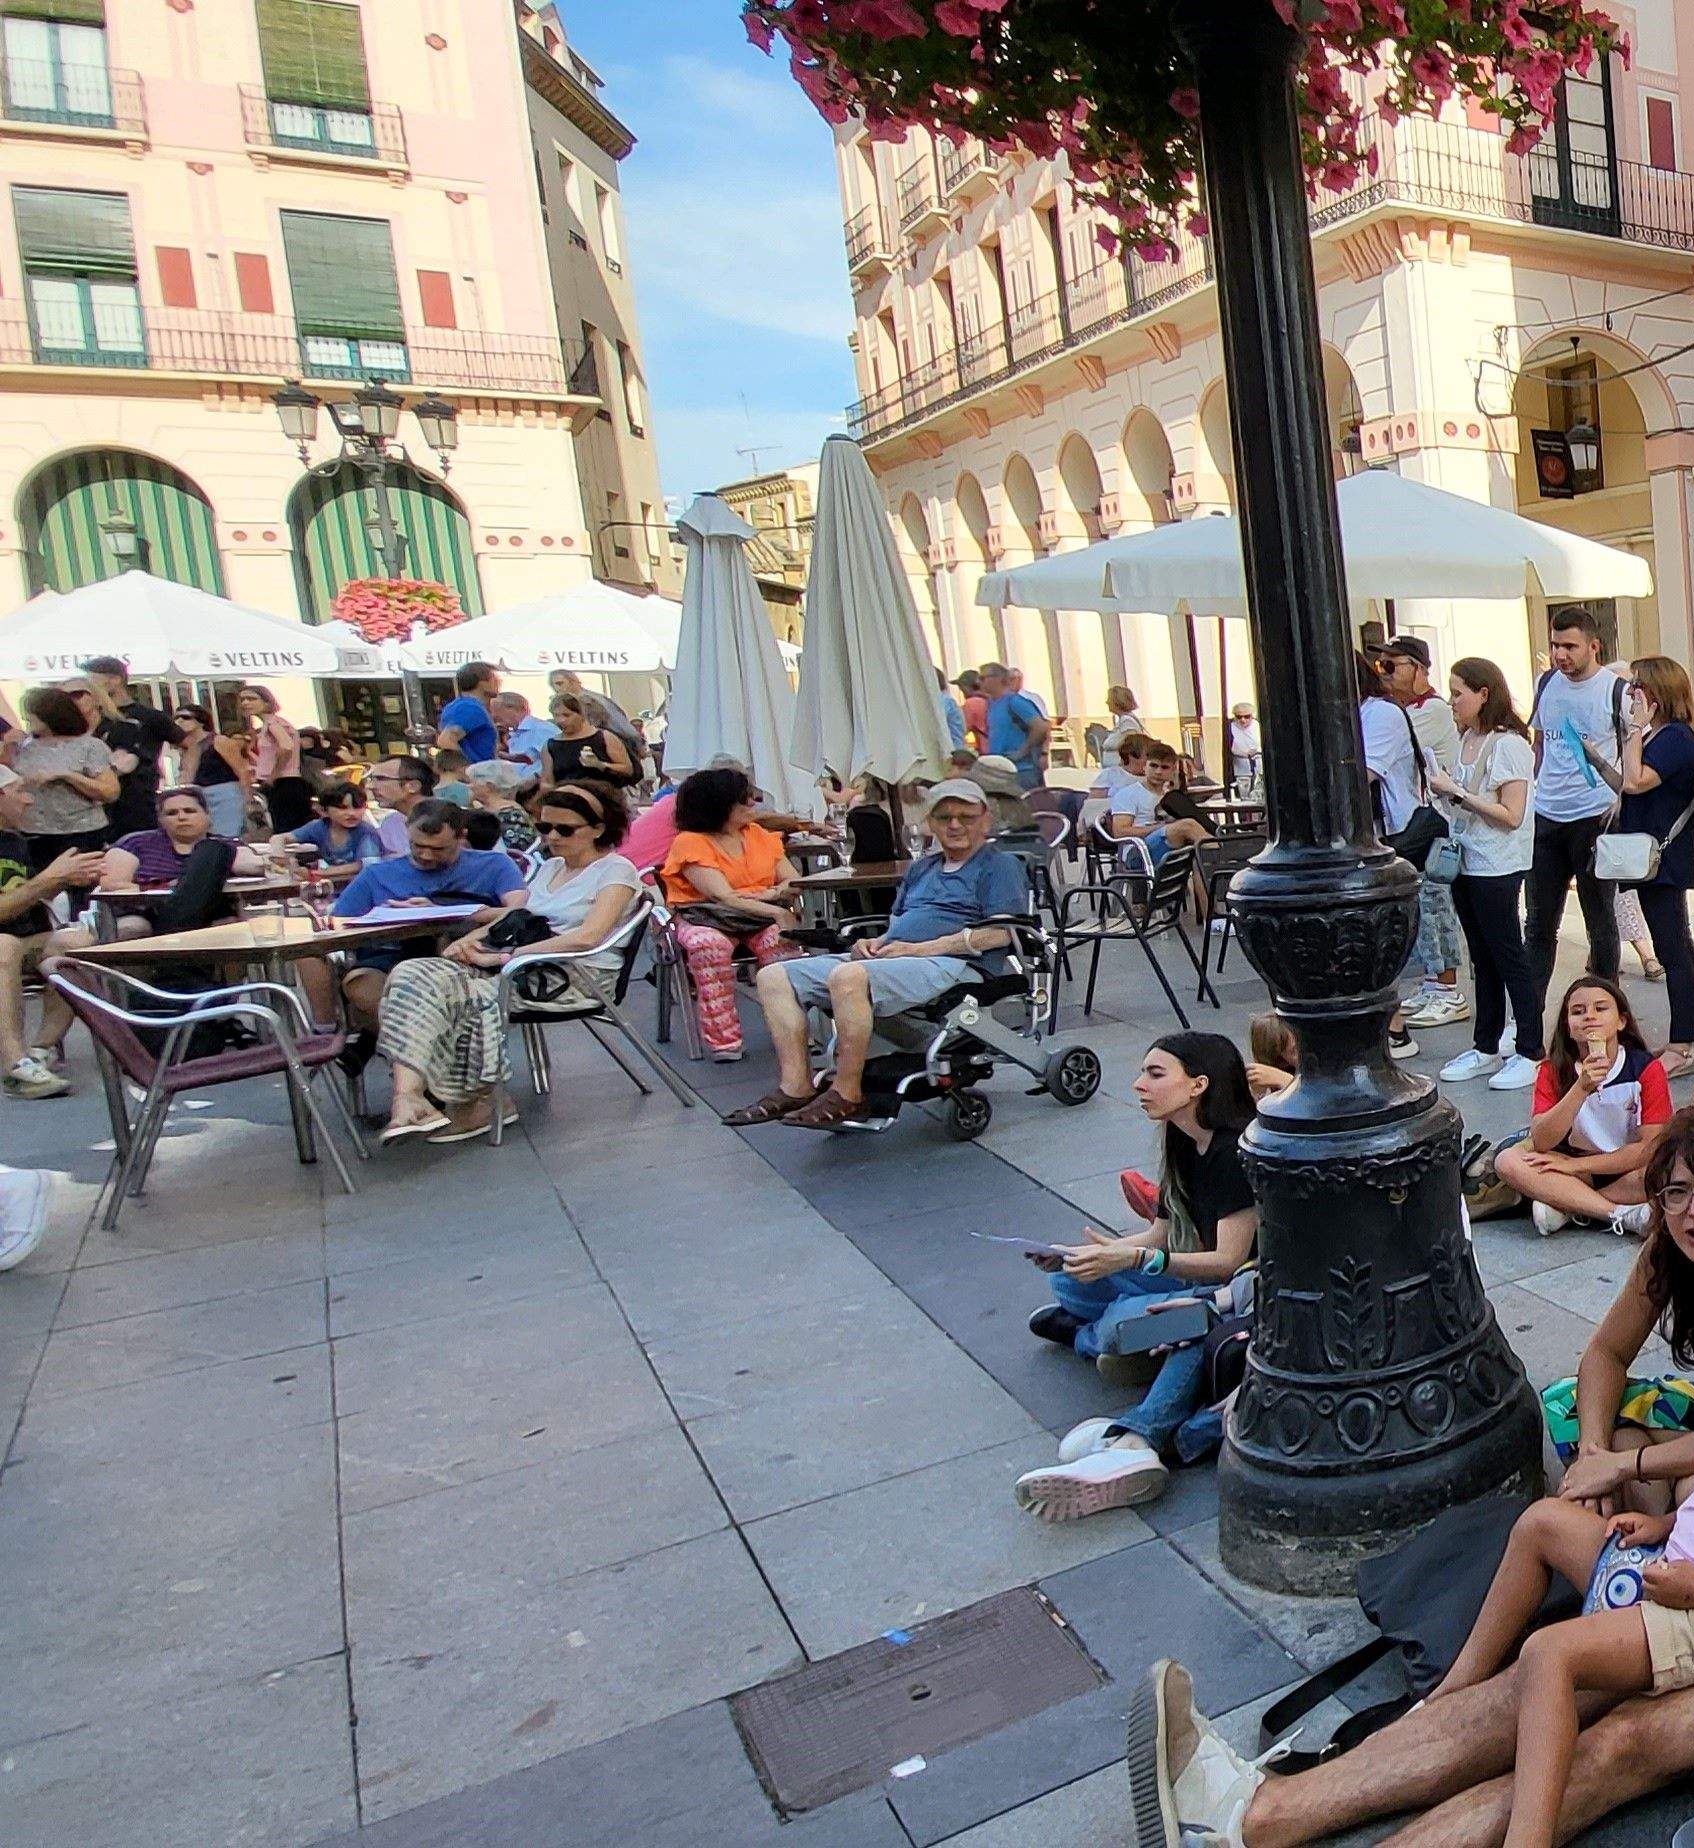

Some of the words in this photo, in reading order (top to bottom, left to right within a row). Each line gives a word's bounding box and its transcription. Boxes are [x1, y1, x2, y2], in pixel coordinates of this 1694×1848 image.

[44, 653, 131, 670] VELS
[224, 651, 304, 667] VELTINS
[554, 651, 629, 665] VELTINS
